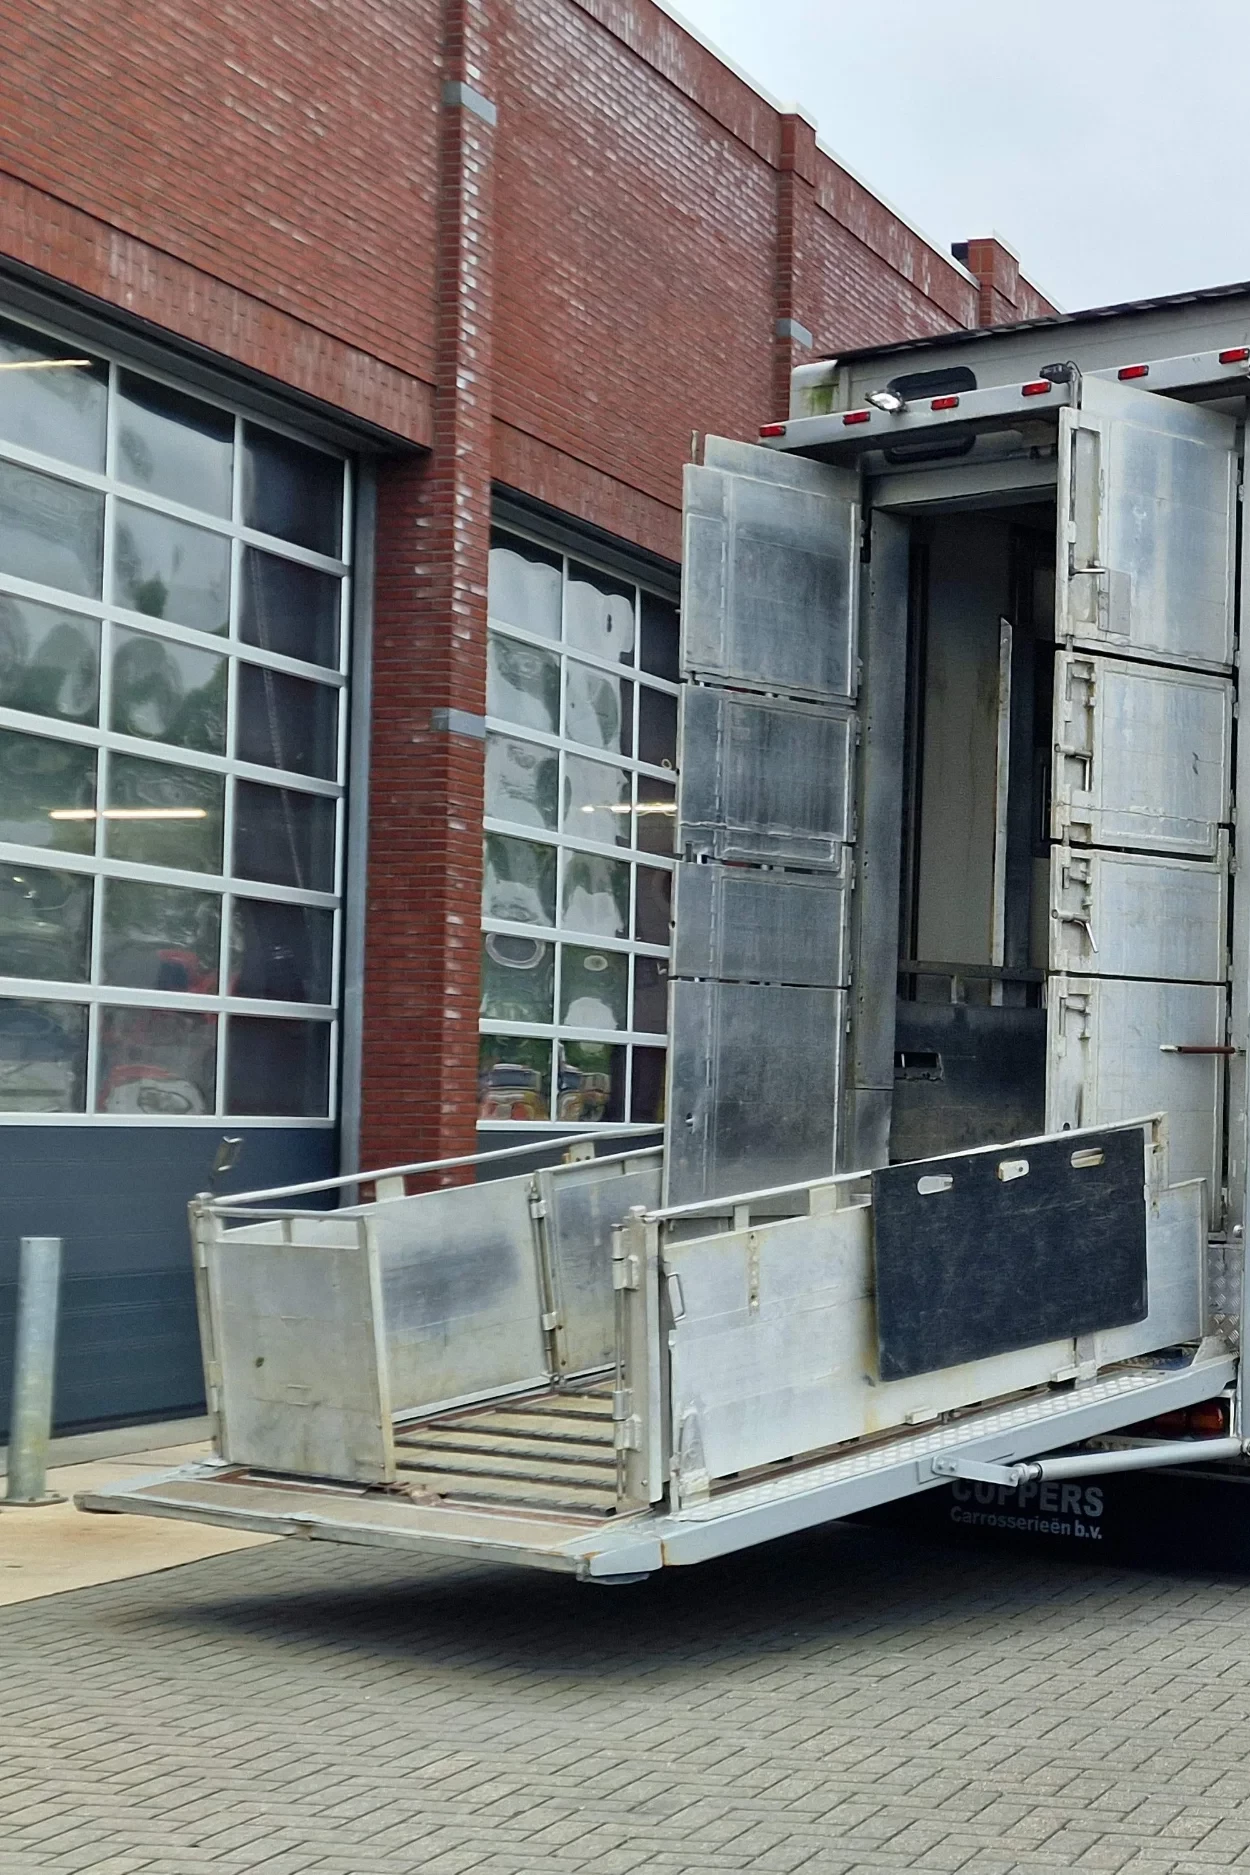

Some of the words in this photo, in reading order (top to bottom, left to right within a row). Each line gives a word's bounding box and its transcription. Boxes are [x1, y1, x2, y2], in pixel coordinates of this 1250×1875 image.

[952, 1479, 1104, 1517] CUPPERS
[950, 1505, 1071, 1536] Carrosserieën
[1074, 1519, 1103, 1540] b.v.
